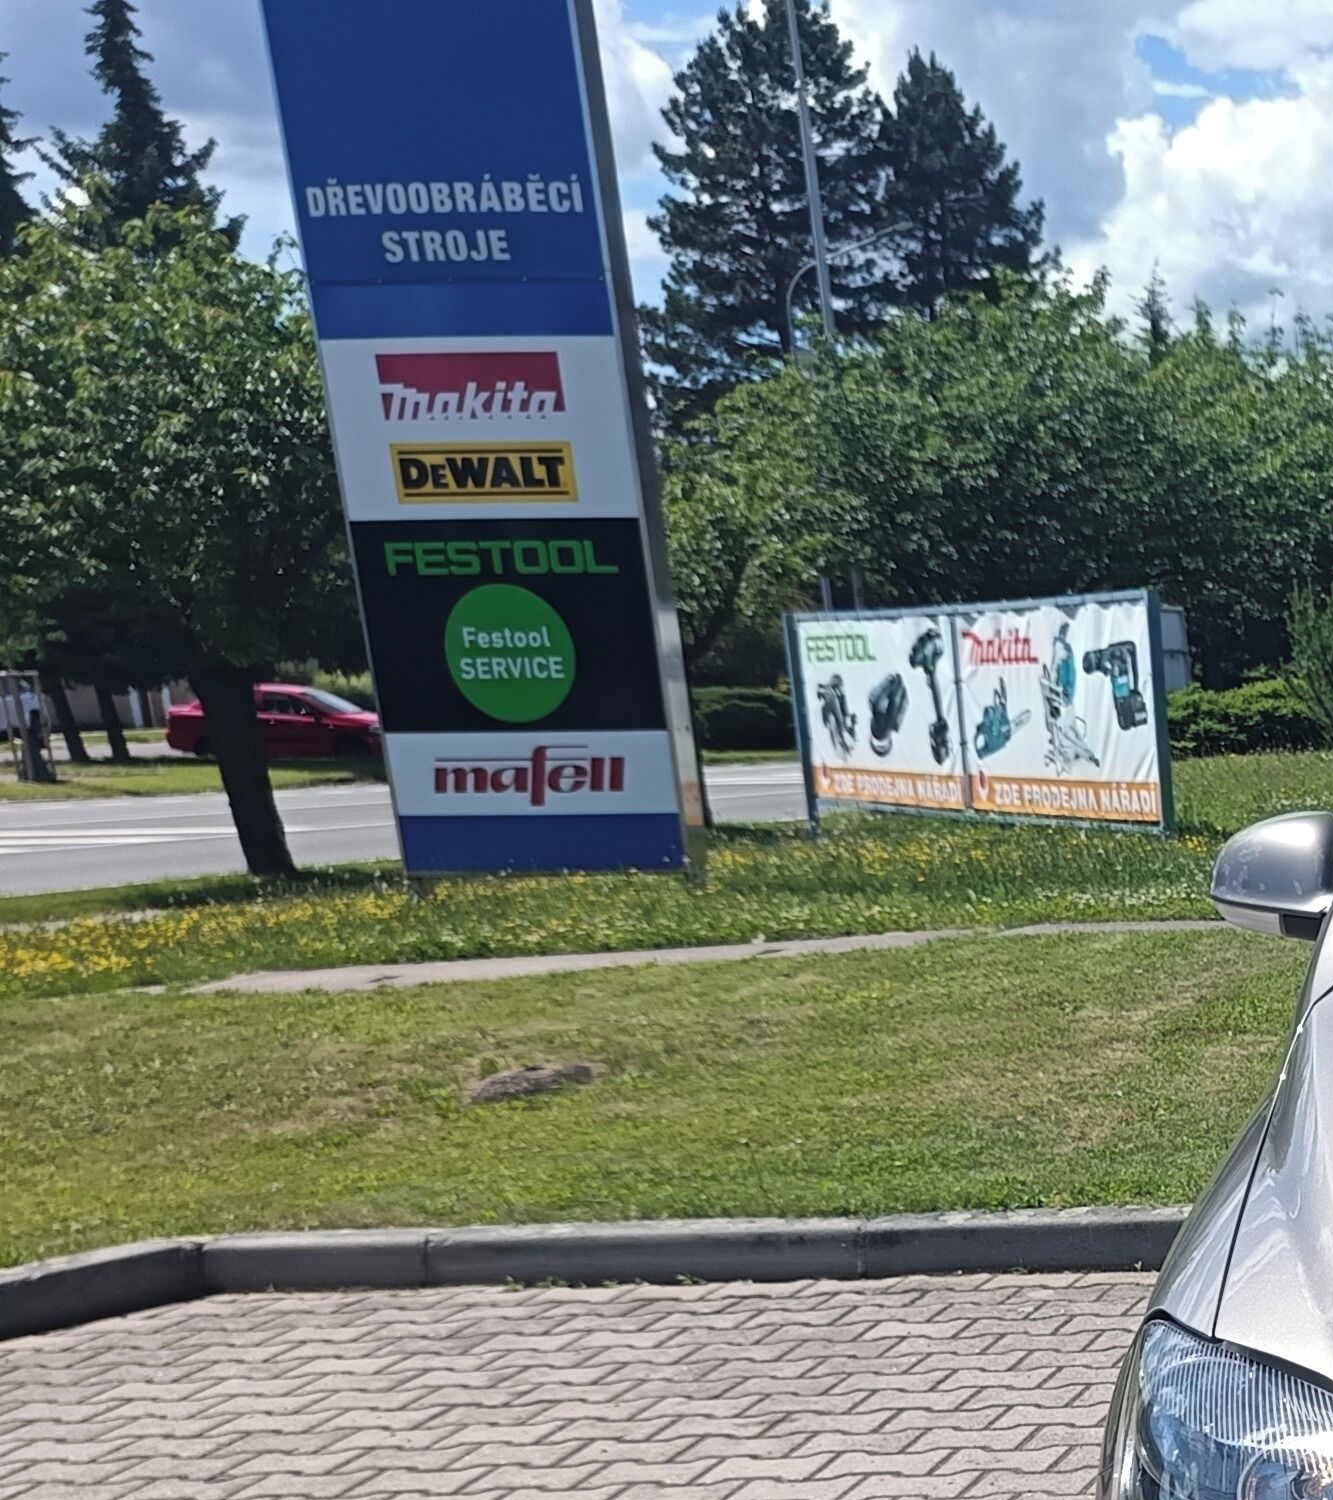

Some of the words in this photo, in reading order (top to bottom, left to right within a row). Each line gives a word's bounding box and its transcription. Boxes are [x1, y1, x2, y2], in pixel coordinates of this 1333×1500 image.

[305, 174, 584, 218] DŘEVOOBRÁBĚCÍ
[381, 229, 511, 263] STROJE
[384, 540, 620, 577] FESTOOL
[462, 626, 551, 649] Festool
[806, 633, 877, 664] FESTOOL
[460, 656, 565, 680] SERVICE
[434, 745, 625, 807] mafell
[994, 782, 1021, 806] ZDE
[1023, 784, 1098, 812] PRODEJNA
[1100, 783, 1157, 815] NÁŘADÍ
